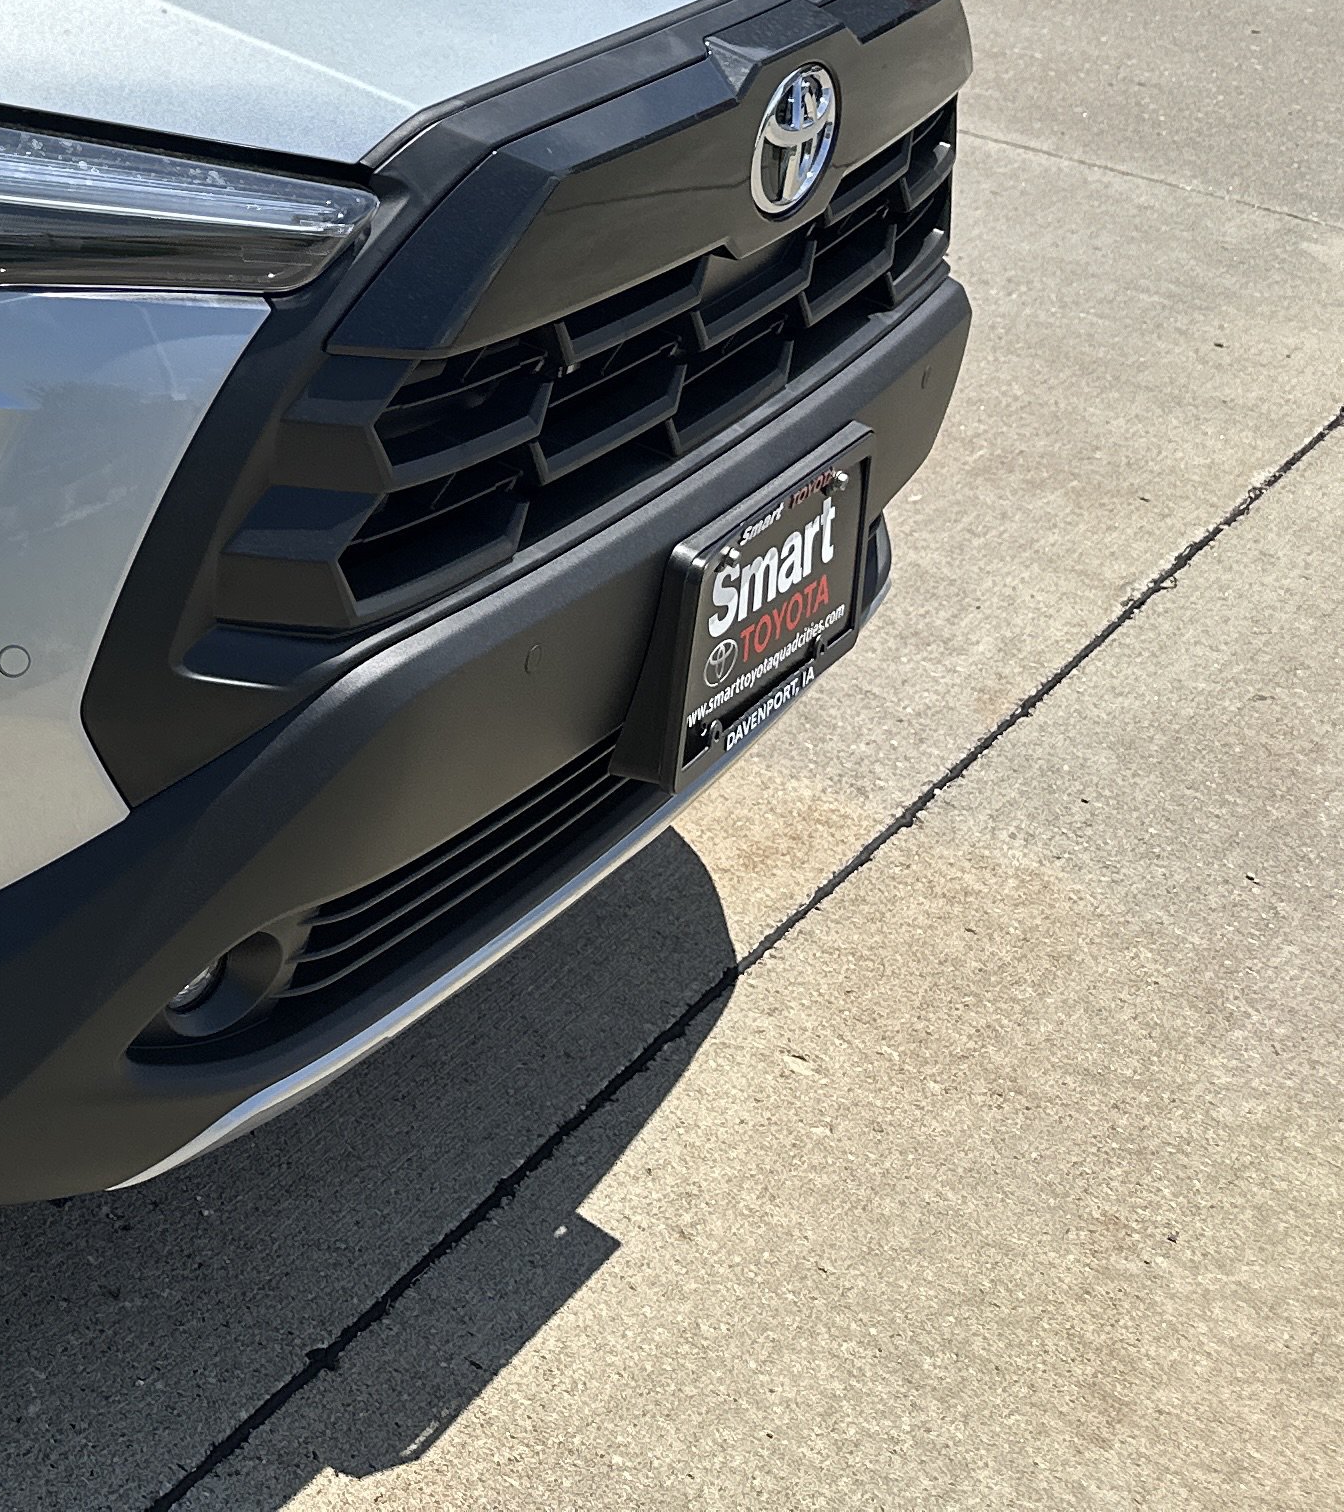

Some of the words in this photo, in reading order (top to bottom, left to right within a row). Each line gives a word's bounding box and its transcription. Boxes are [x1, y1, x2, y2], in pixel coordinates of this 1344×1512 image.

[709, 497, 836, 638] Smart
[740, 501, 784, 546] Smart
[740, 574, 829, 663] TOYOTA
[686, 604, 846, 728] ww.smarttoyotaquadcities.com
[726, 677, 800, 751] DAVENPORT,
[801, 666, 815, 689] IA
